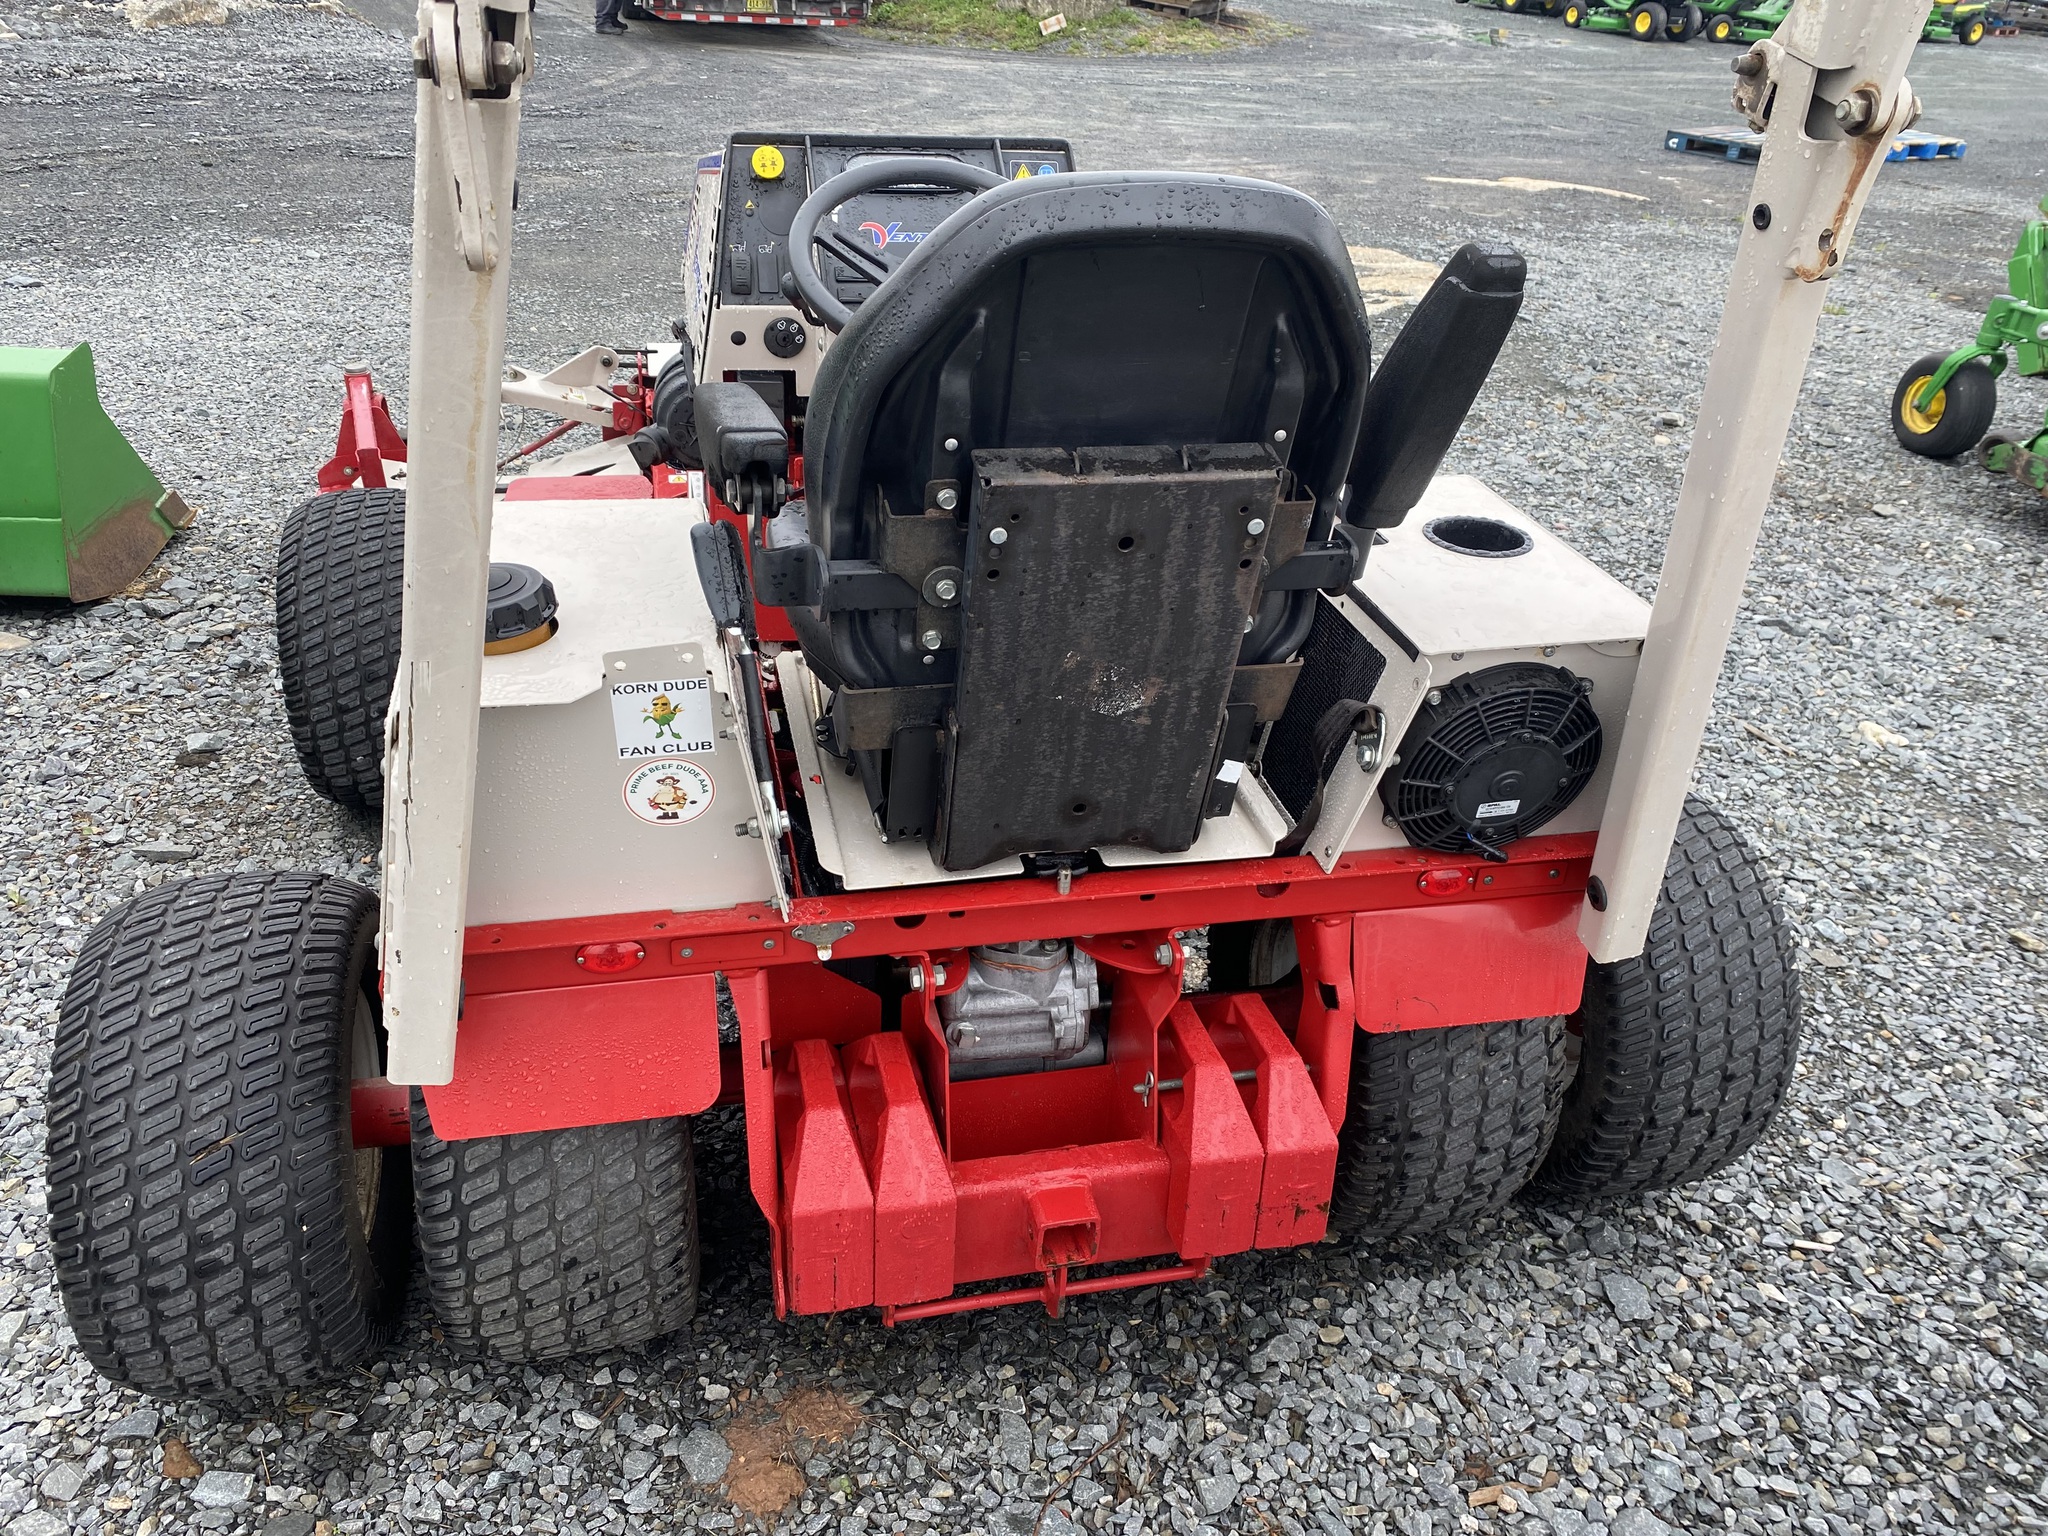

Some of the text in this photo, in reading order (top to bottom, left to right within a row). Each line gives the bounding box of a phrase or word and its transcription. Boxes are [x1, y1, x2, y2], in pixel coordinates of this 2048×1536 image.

[612, 679, 708, 696] KORN DUDE
[620, 741, 713, 757] FAN CLUB
[630, 763, 709, 794] PRIME BEEF DUDE AAA
